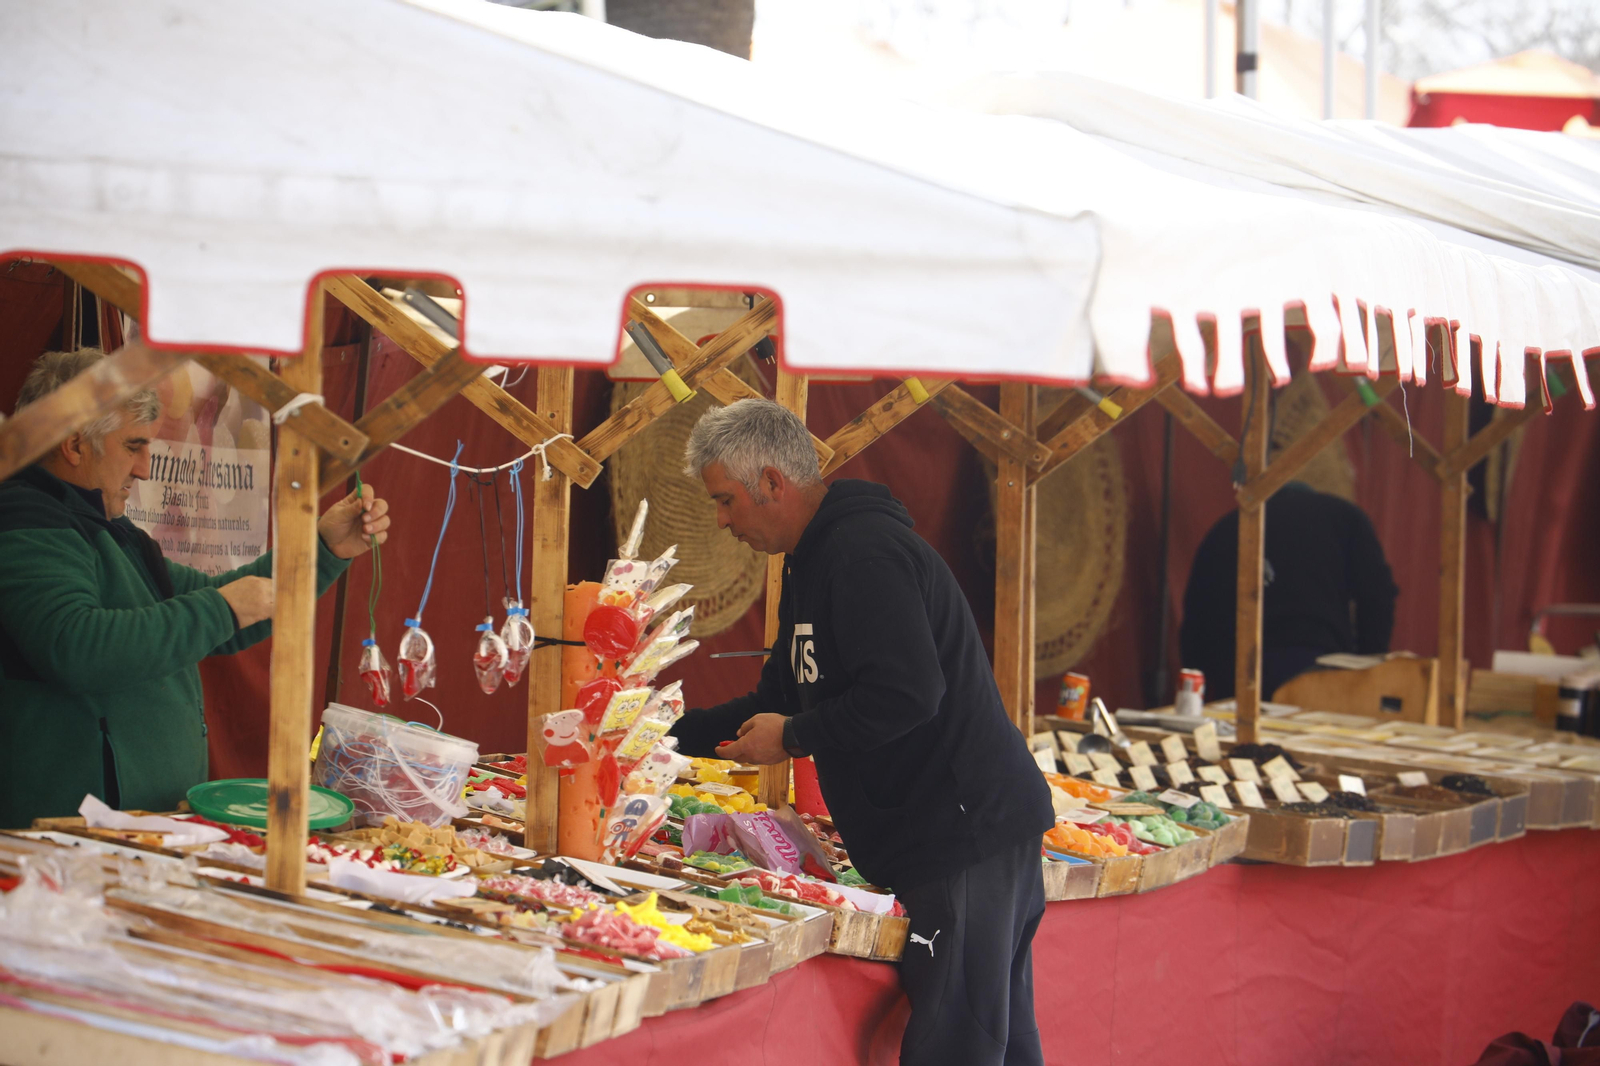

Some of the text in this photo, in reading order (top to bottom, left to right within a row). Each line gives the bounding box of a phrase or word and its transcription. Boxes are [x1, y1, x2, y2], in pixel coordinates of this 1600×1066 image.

[160, 485, 188, 509] Pasta
[217, 516, 252, 531] naturales.
[230, 540, 241, 556] los
